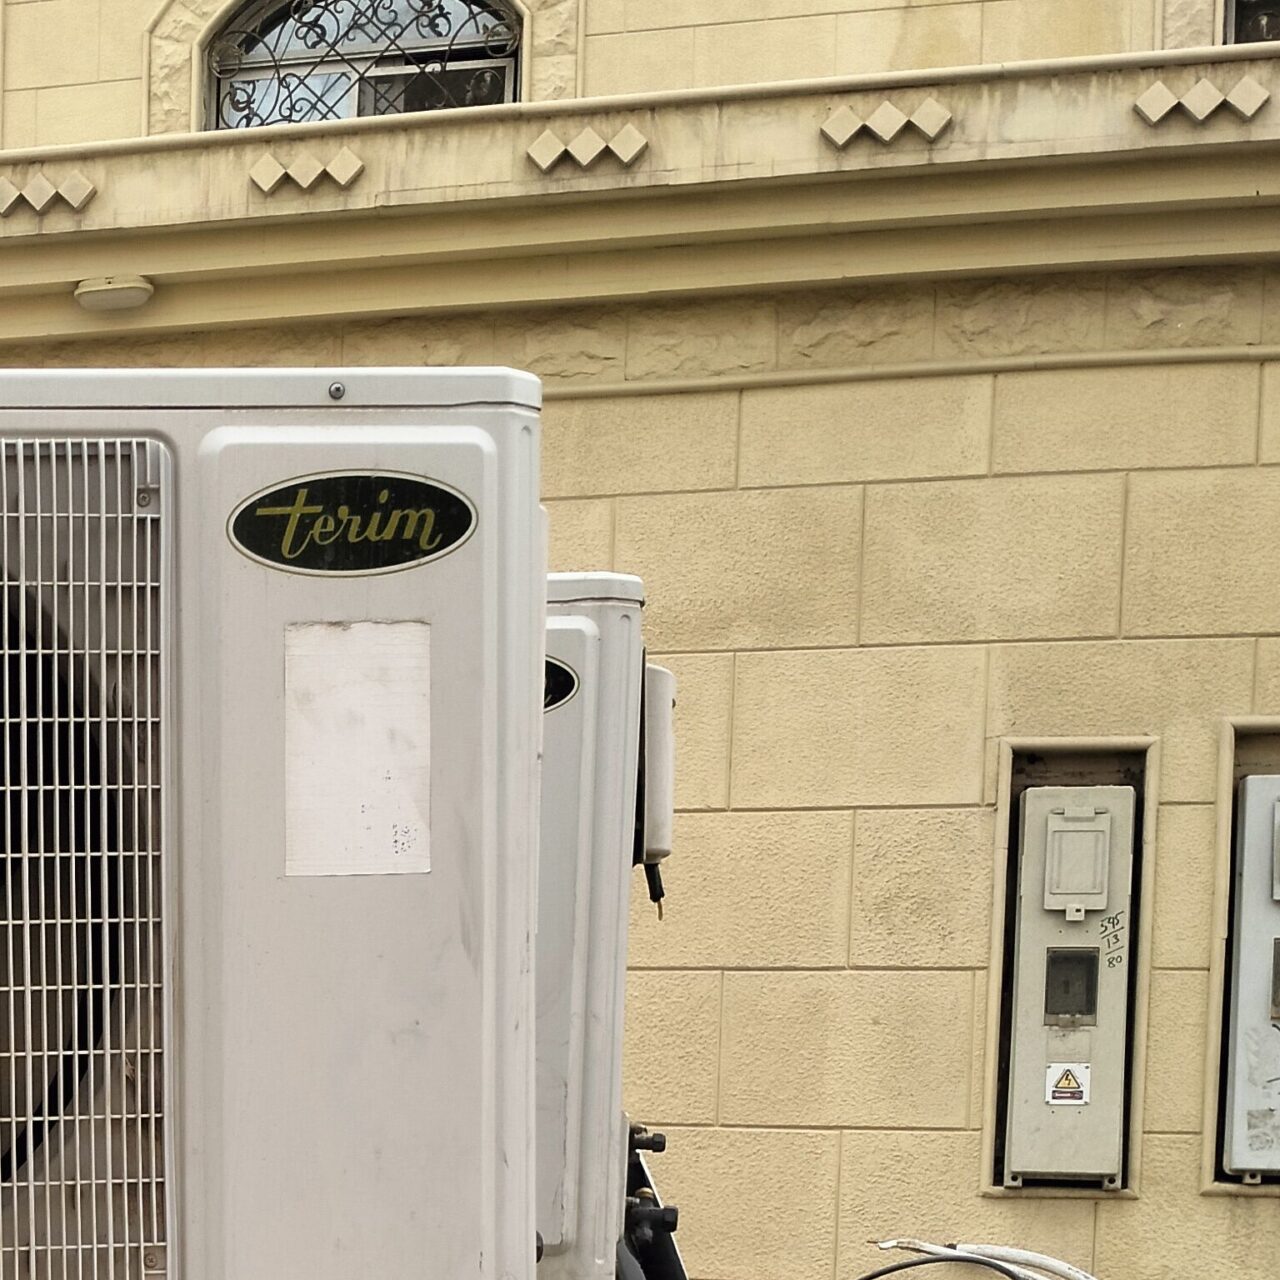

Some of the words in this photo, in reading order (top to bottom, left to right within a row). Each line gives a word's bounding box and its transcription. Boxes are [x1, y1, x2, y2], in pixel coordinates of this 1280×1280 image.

[256, 488, 443, 560] terim
[1106, 933, 1120, 949] 13
[1107, 955, 1123, 968] 80
